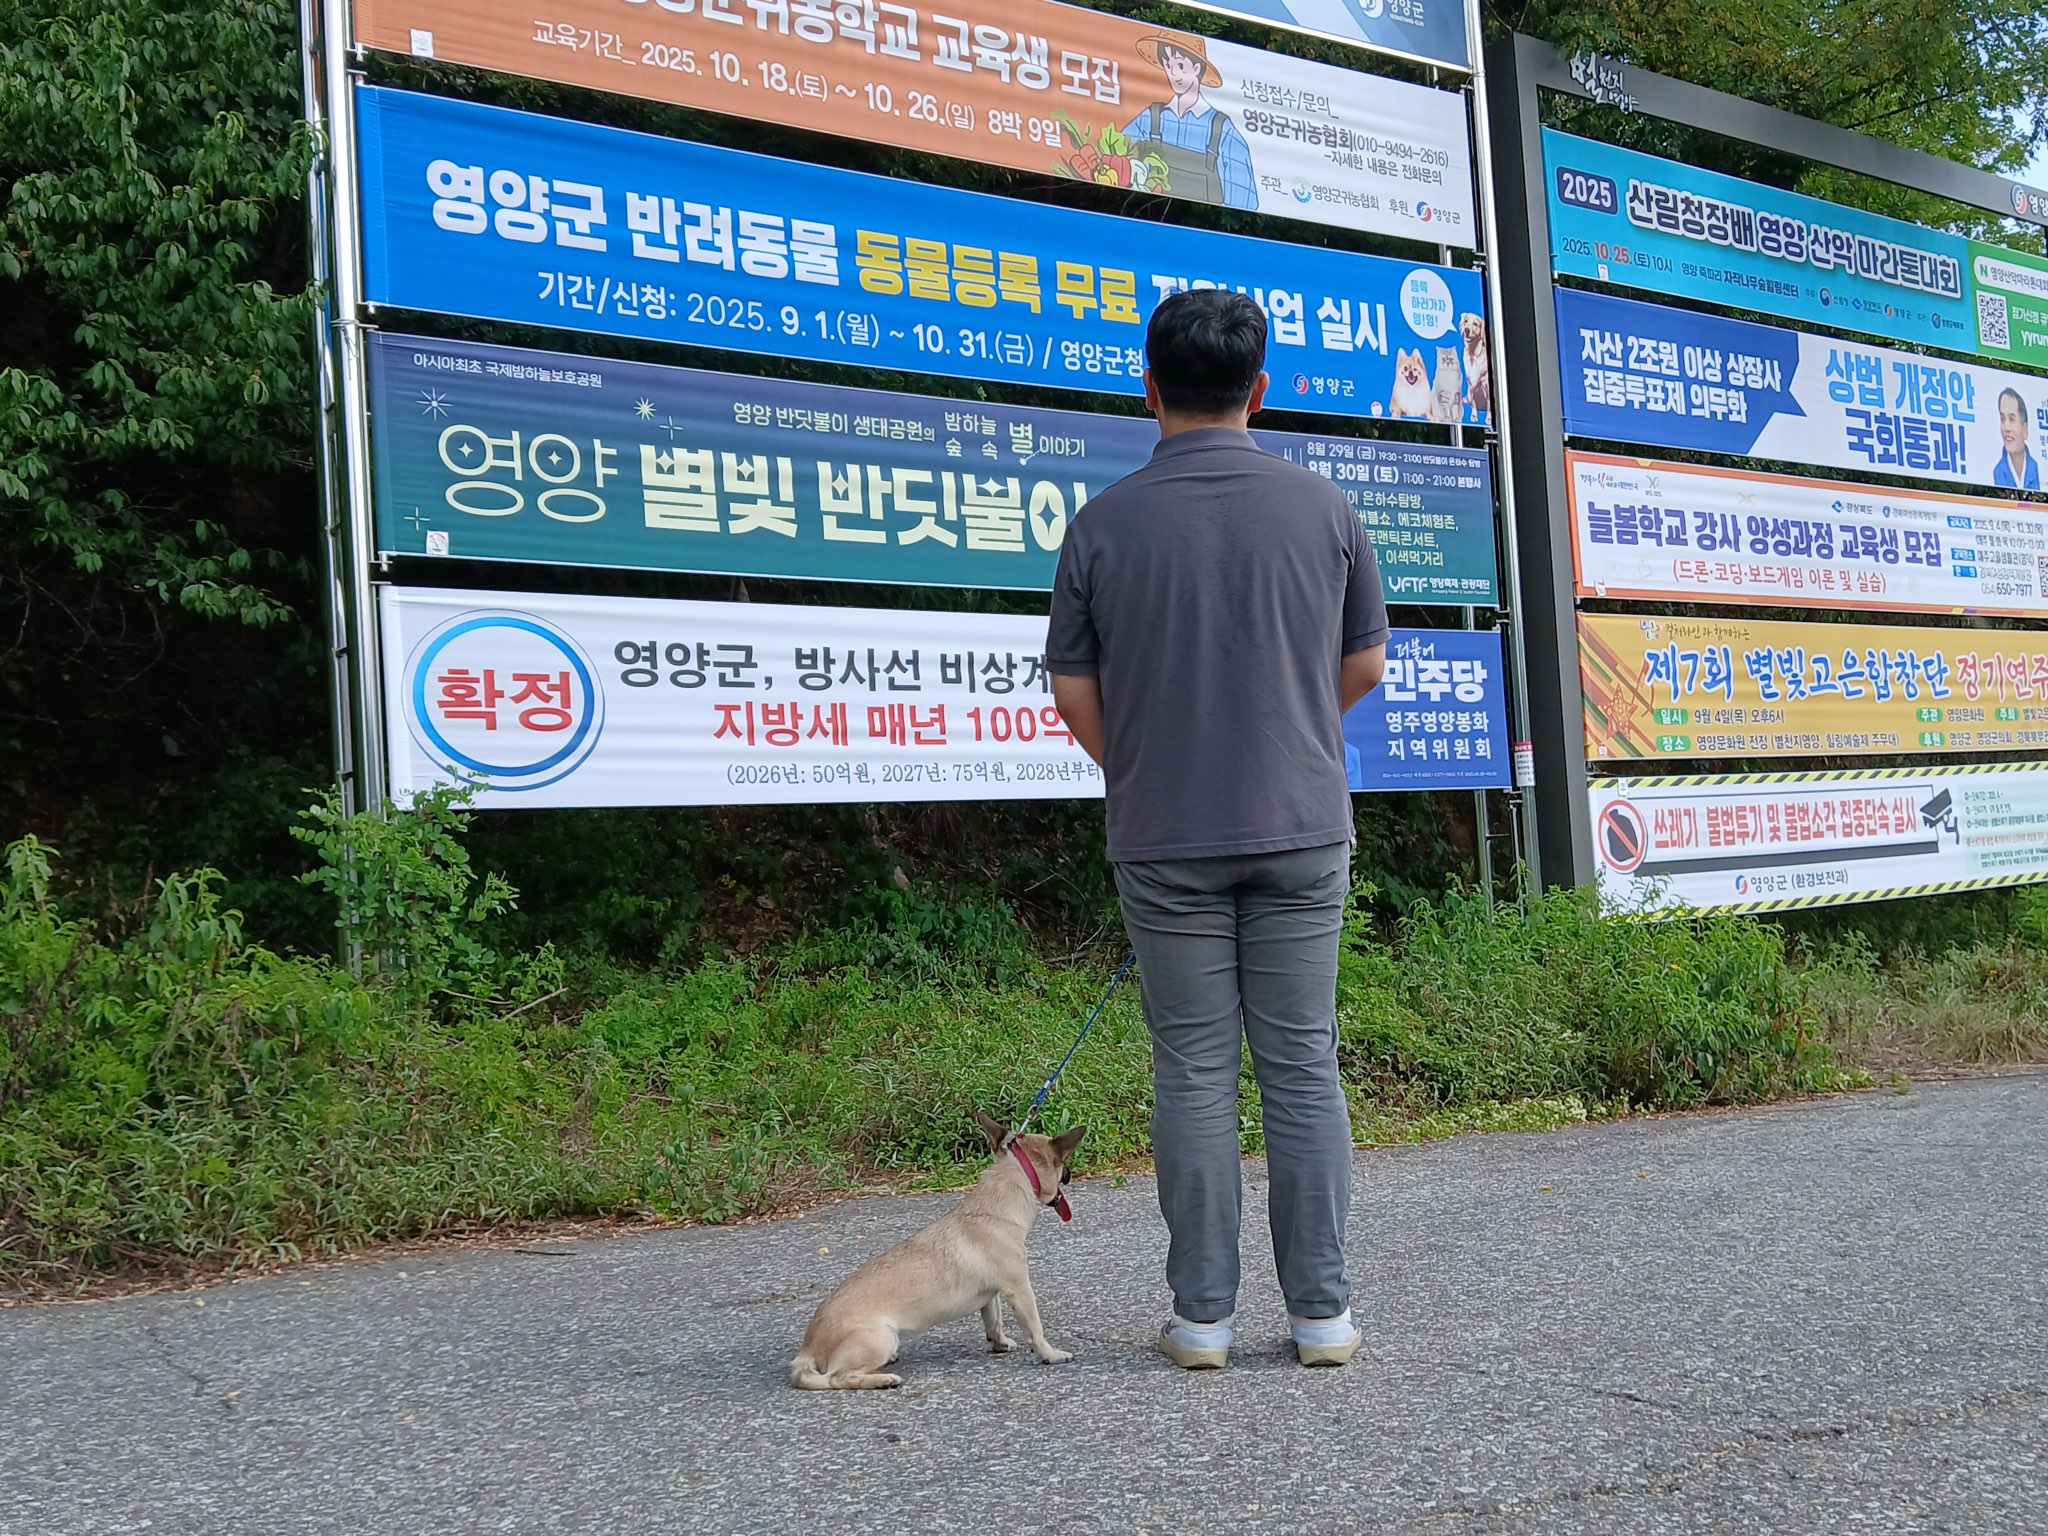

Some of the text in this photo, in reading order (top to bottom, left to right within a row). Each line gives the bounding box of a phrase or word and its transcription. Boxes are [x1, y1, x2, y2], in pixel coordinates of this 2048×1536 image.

[932, 13, 1121, 105] 교육생 모집
[641, 41, 703, 77] 2025.
[709, 50, 749, 87] 10.
[757, 60, 828, 102] 18.(토)
[864, 82, 900, 117] 10.
[908, 91, 975, 131] 26.(일)
[988, 109, 1023, 140] 8박
[1028, 116, 1062, 148] 9일
[1366, 157, 1399, 177] 내용은
[1401, 163, 1443, 186] 전화문의
[1311, 185, 1380, 211] 영양군귀농협회
[1432, 207, 1461, 225] 영양군
[1561, 171, 1961, 297] 2025 산림청장배 영양 산악 마라톤대회
[426, 159, 1388, 356] 영양군 반려동물 동물등록 무료 실시
[1561, 236, 1593, 257] 2025.
[1593, 241, 1612, 261] 10.
[1613, 246, 1633, 265] 25.
[1633, 250, 1651, 269] (토)
[1652, 256, 1673, 274] 10시
[1681, 262, 1698, 277] 영양
[1723, 269, 1799, 298] 자작나무숲힐링센터
[1411, 279, 1428, 294] 등록
[1411, 295, 1447, 312] 하러가자
[537, 270, 1145, 378] 기간/신청: 2025. 9. 1.(월) 10. 31.(금) 영양군청
[1413, 312, 1439, 328] 멍!멍!
[413, 353, 603, 388] 아시아최초 국제밤하늘보호공원
[1579, 328, 1782, 393] 자산 2조원 이상 상장사
[1311, 376, 1356, 397] 영양군
[1582, 368, 1748, 424] 집중투표제 의무화
[1825, 348, 1976, 423] 상법 개정안
[733, 401, 1086, 459] 영양 반딧불이 생태공원의 밤하늘 별 이야기
[1845, 407, 1967, 475] 국회통과!
[945, 436, 999, 461] 숲 속
[1306, 441, 1326, 457] 8월
[1328, 443, 1355, 460] 29일
[1356, 445, 1376, 461] (금)
[1403, 453, 1422, 465] 21:00
[1422, 455, 1449, 466] 반딧불이
[1449, 457, 1468, 467] 은하수
[438, 424, 619, 523] 영양
[639, 443, 799, 539] 별빛
[1336, 462, 1370, 483] 30일
[1374, 465, 1399, 485] (토)
[1402, 472, 1424, 485] 11:00
[1432, 475, 1456, 488] 21:00
[1457, 475, 1482, 490] 본행사
[1362, 490, 1426, 511] 은하수탐방,
[1397, 511, 1460, 532] 에코체험존,
[1587, 500, 1689, 548] 늘봄학교
[1693, 511, 1741, 553] 강사
[1746, 514, 1834, 560] 양성과정
[1839, 524, 1900, 565] 교육생
[1904, 530, 1943, 568] 모집
[1385, 548, 1444, 567] 이색먹거리
[1387, 575, 1429, 593] YFTF
[1673, 559, 1888, 594] (드론·코딩·보드게임 이론 및 실습)
[1713, 623, 1750, 641] 함께하는
[1394, 636, 1436, 663] 더불어
[613, 640, 774, 692] 영양군,
[794, 645, 921, 692] 방사선
[1645, 644, 1733, 700] 제7회
[1744, 645, 1949, 701] 별빛고은합창단
[1381, 658, 1488, 704] 민주당
[436, 668, 573, 732] 확정
[712, 700, 849, 747] 지방세
[866, 704, 948, 746] 매년
[1385, 710, 1490, 734] 영주영양봉화
[1660, 708, 1683, 725] 일시
[1694, 708, 1785, 725] 9월 4일(목) 오후6시
[1920, 707, 1985, 722] 주관 영양문화원
[1999, 707, 2017, 721] 주최
[1662, 736, 1686, 752] 장소
[1696, 735, 1746, 751] 영양문화원
[1749, 734, 1769, 750] 전정
[1826, 732, 1870, 749] 힐링예술제
[1871, 731, 1900, 748] 주무대)
[1922, 731, 1942, 747] 후원
[726, 762, 806, 785] (2026년:
[812, 762, 877, 786] 50억원,
[882, 762, 948, 784] 2027년:
[952, 761, 1014, 784] 75억원,
[1653, 796, 1917, 849] 쓰레기 불법투기 및 불법소각 집중단속 실시
[1750, 869, 1849, 894] 영양군 (환경보전과)
